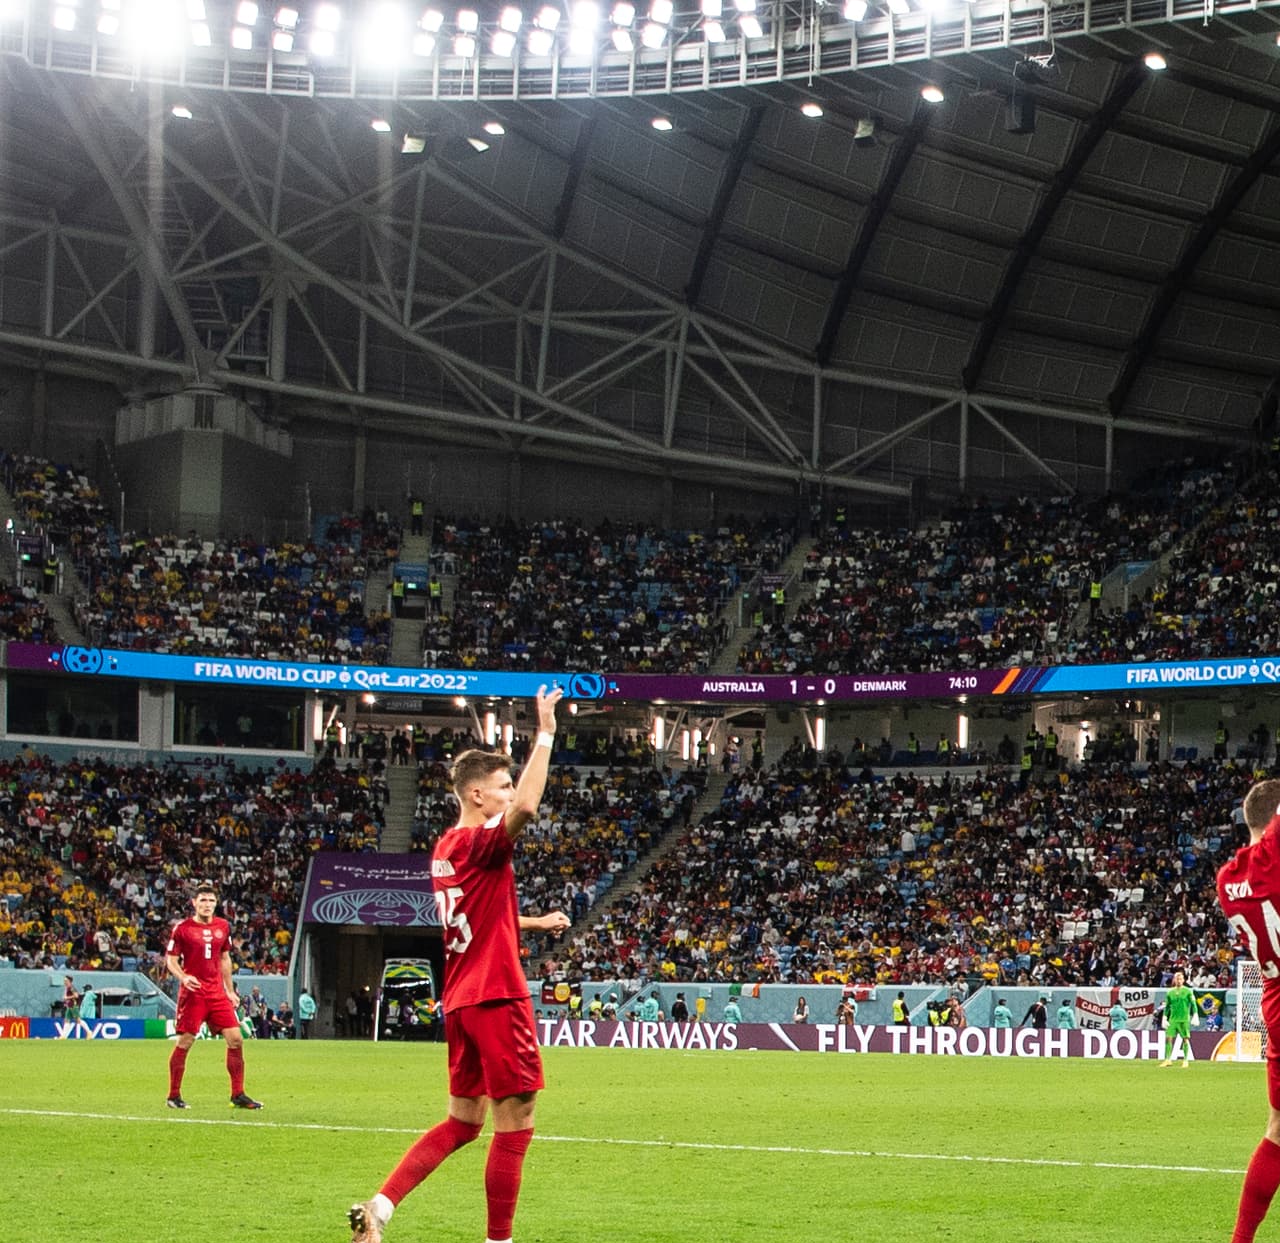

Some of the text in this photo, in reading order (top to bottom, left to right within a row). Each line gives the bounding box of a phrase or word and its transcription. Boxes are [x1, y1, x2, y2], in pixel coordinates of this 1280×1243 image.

[194, 662, 232, 677] FIFA
[235, 665, 299, 682] WORLD
[302, 668, 337, 684] CUP
[1126, 666, 1159, 683] FIFA
[1159, 665, 1215, 681] WORLD
[1217, 664, 1247, 680] CUP
[702, 681, 765, 692] AUSTRALIA
[824, 679, 836, 694] 0
[853, 680, 907, 692] DENMARK
[948, 676, 978, 690] 74:10
[1124, 990, 1149, 1002] ROB
[1081, 1001, 1148, 1017] CARLIS OYAL
[535, 1019, 739, 1051] TAR AIRWAYS
[815, 1024, 1195, 1061] FLY THROUGH DOHA
